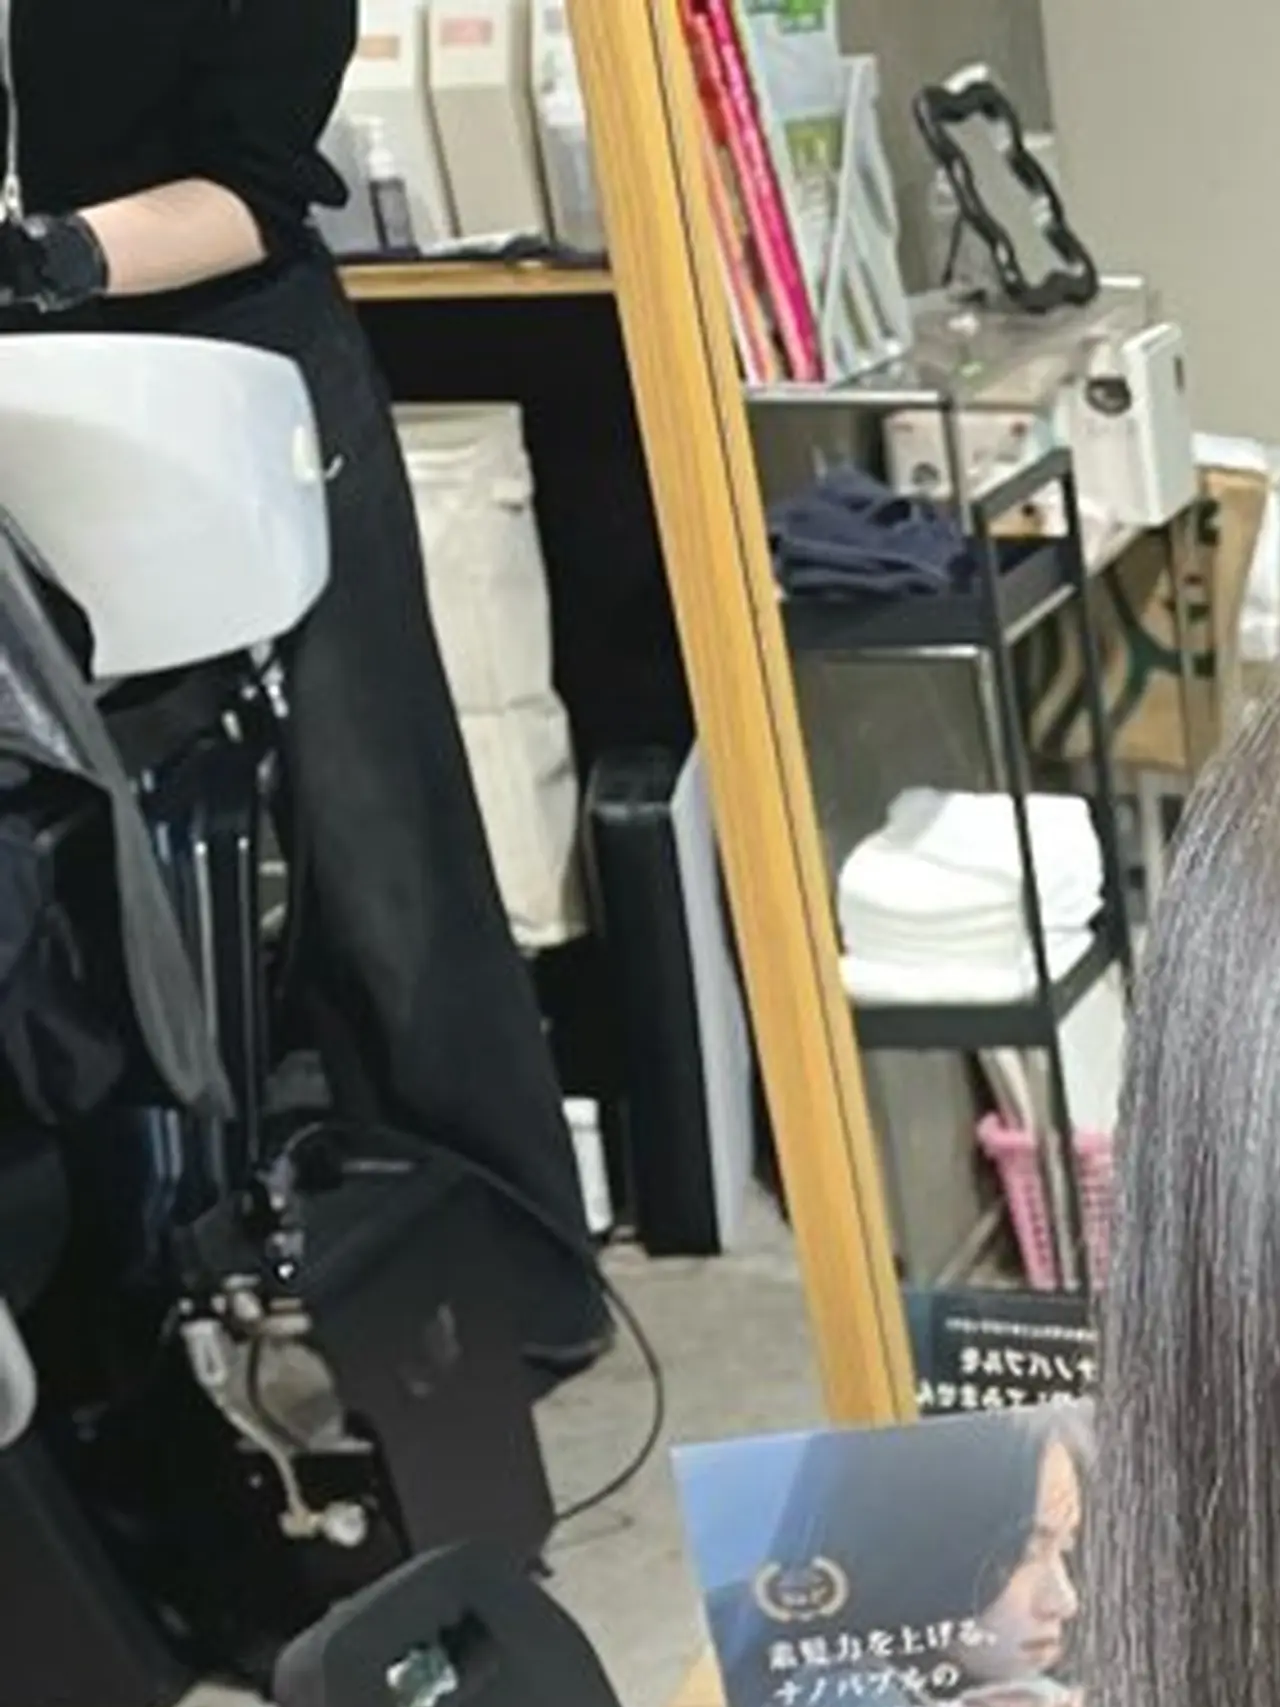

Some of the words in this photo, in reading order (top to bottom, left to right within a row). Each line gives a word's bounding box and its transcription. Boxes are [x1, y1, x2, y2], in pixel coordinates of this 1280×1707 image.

[773, 1660, 961, 1707] ナノバブルの
